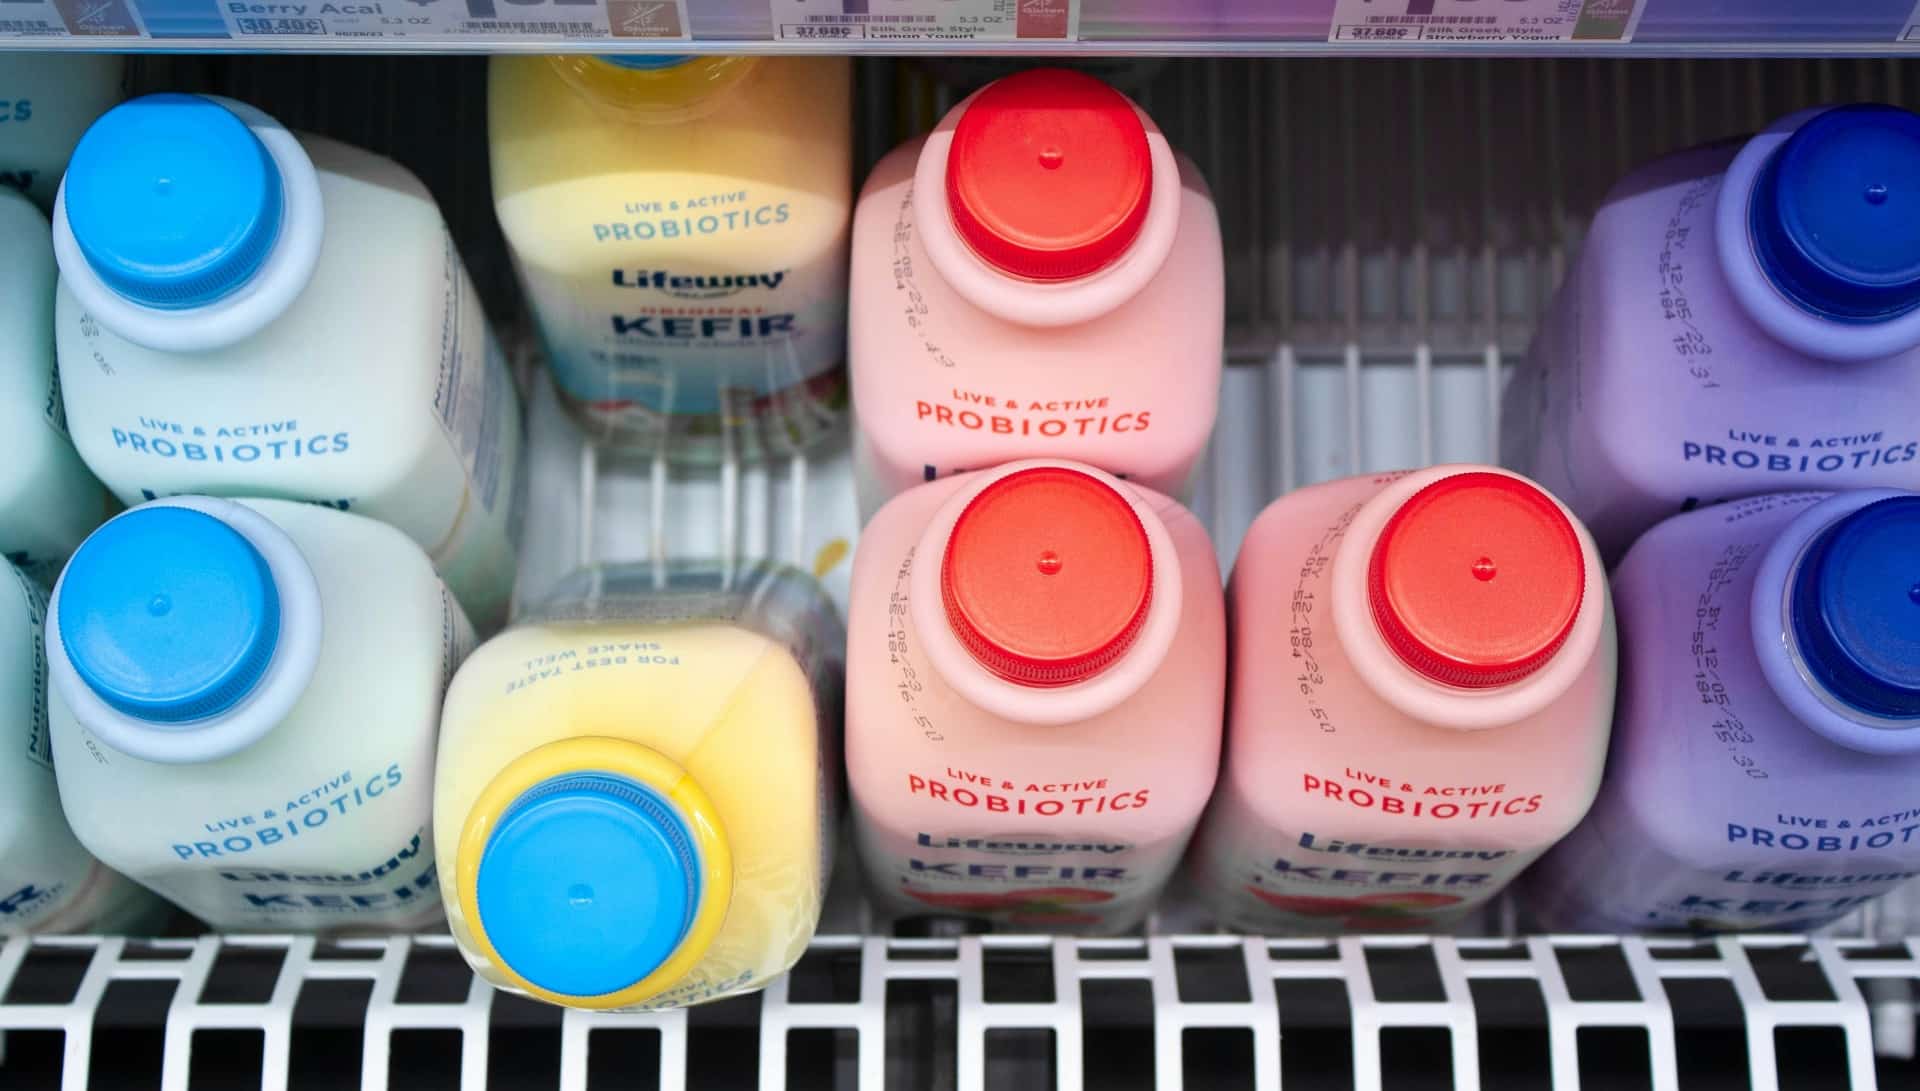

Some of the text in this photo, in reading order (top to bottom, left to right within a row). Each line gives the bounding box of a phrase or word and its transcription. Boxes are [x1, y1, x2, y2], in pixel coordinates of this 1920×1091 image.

[228, 3, 383, 16] Berry Acai
[407, 17, 432, 25] OZ
[870, 25, 897, 33] Silk
[950, 26, 986, 34] Style
[1426, 26, 1455, 34] Silk
[1506, 27, 1544, 35] Style
[625, 191, 747, 214] LIVE & ACTIVE
[593, 203, 790, 242] PROBIOTICS
[612, 269, 785, 289] Lifeway
[612, 314, 798, 338] KEFIR
[952, 388, 1111, 411] LIVE & ACTIVE
[139, 416, 297, 437] LIVE & ACTIVE
[916, 400, 1151, 436] PROBIOTICS
[112, 426, 350, 463] PROBIOTICS
[1729, 429, 1884, 448] LIVE & ACTIVE
[1683, 441, 1918, 472] PROBIOTICS
[1300, 592, 1324, 686] 12/08/23
[526, 642, 662, 670] SHAKE WELL
[506, 655, 679, 694] FOR BEST TASTE
[29, 634, 41, 754] Nutrition
[1705, 647, 1755, 744] 12/05/23
[947, 767, 1109, 793] LIVE & ACTIVE
[1346, 767, 1507, 796] LIVE & ACTIVE
[205, 771, 353, 832] LIVE & ACTIVE
[908, 774, 1150, 816] PROBIOTICS
[1303, 774, 1543, 819] PROBIOTICS
[172, 763, 403, 860] PROBIOTICS
[1777, 813, 1829, 829] LIVE
[1837, 820, 1852, 829] &
[909, 859, 1127, 880] KEFIR
[1275, 862, 1492, 885] KEFIR
